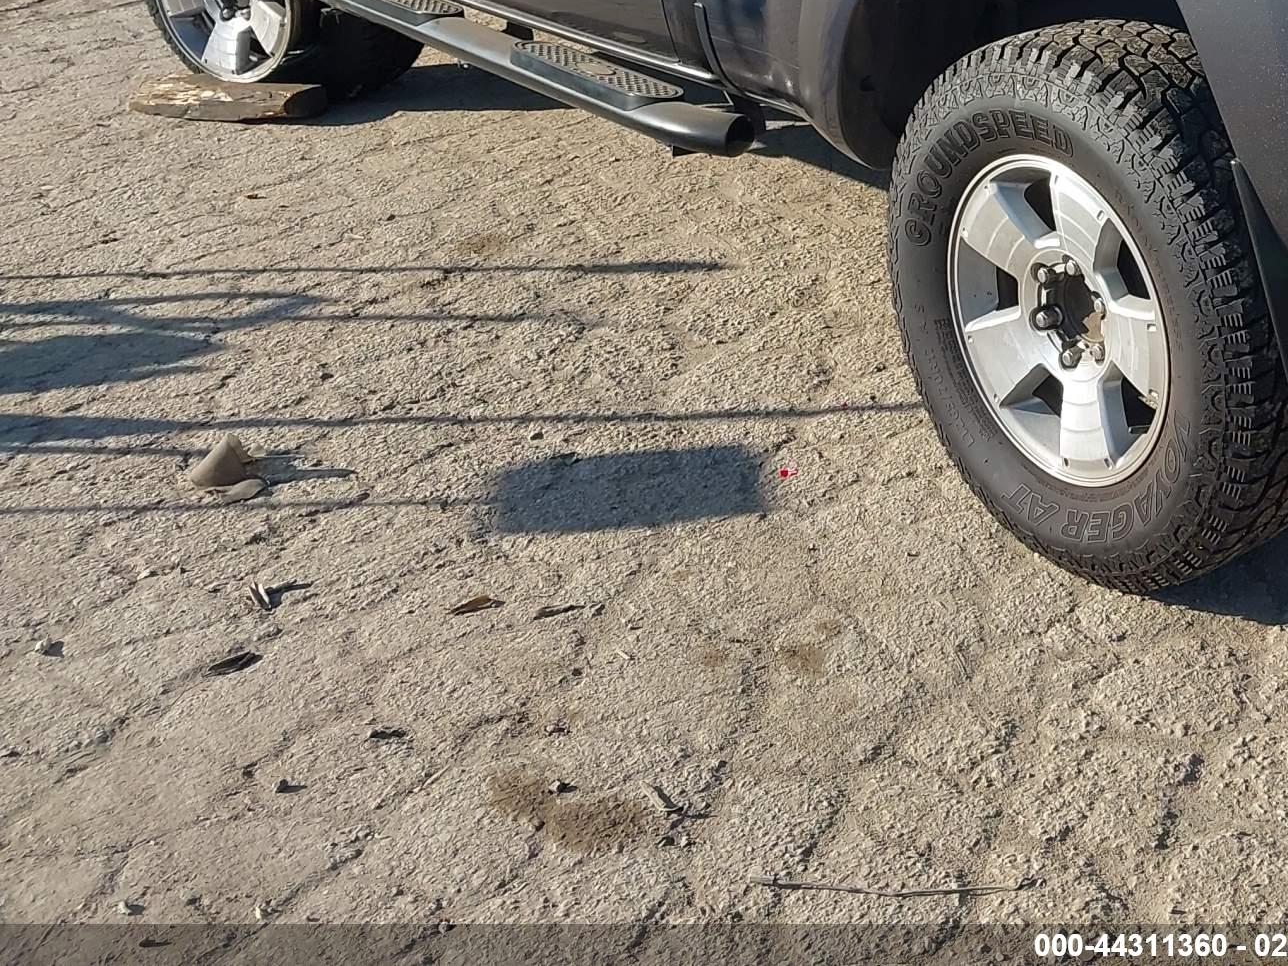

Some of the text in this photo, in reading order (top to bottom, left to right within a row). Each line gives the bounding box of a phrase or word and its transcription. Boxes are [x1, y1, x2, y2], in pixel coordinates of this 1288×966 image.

[904, 109, 1074, 247] GROUNDSPEED
[1001, 483, 1061, 527] AT
[1060, 410, 1191, 544] VOYAGER
